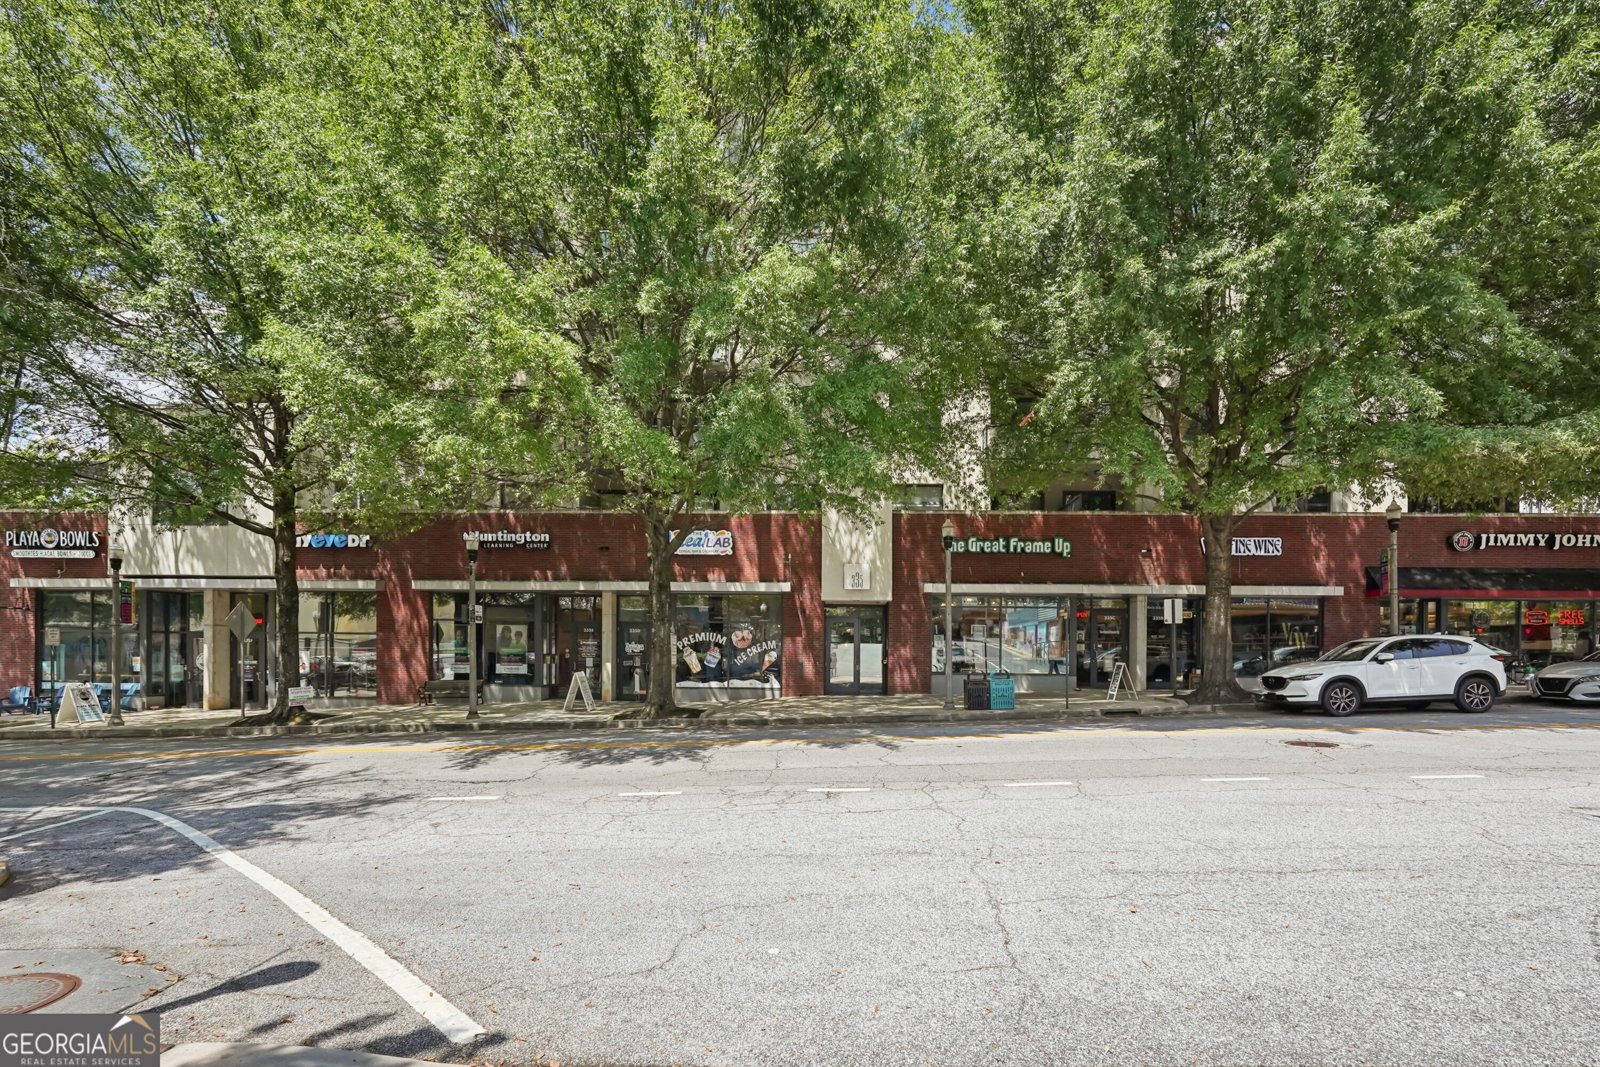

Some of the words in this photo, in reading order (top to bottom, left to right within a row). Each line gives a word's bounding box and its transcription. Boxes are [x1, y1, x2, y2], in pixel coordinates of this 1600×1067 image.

[5, 530, 40, 547] PLAYA
[60, 531, 100, 547] BOWLS
[968, 537, 1006, 553] Great
[1009, 537, 1052, 553] Frame
[1054, 537, 1071, 557] Up
[1253, 539, 1280, 554] WINE
[1480, 533, 1550, 550] JIMMY
[851, 572, 864, 588] 335
[1558, 610, 1582, 619] FREE
[677, 632, 727, 650] PREMIUM
[734, 651, 748, 666] ICE
[746, 640, 777, 658] CREAM
